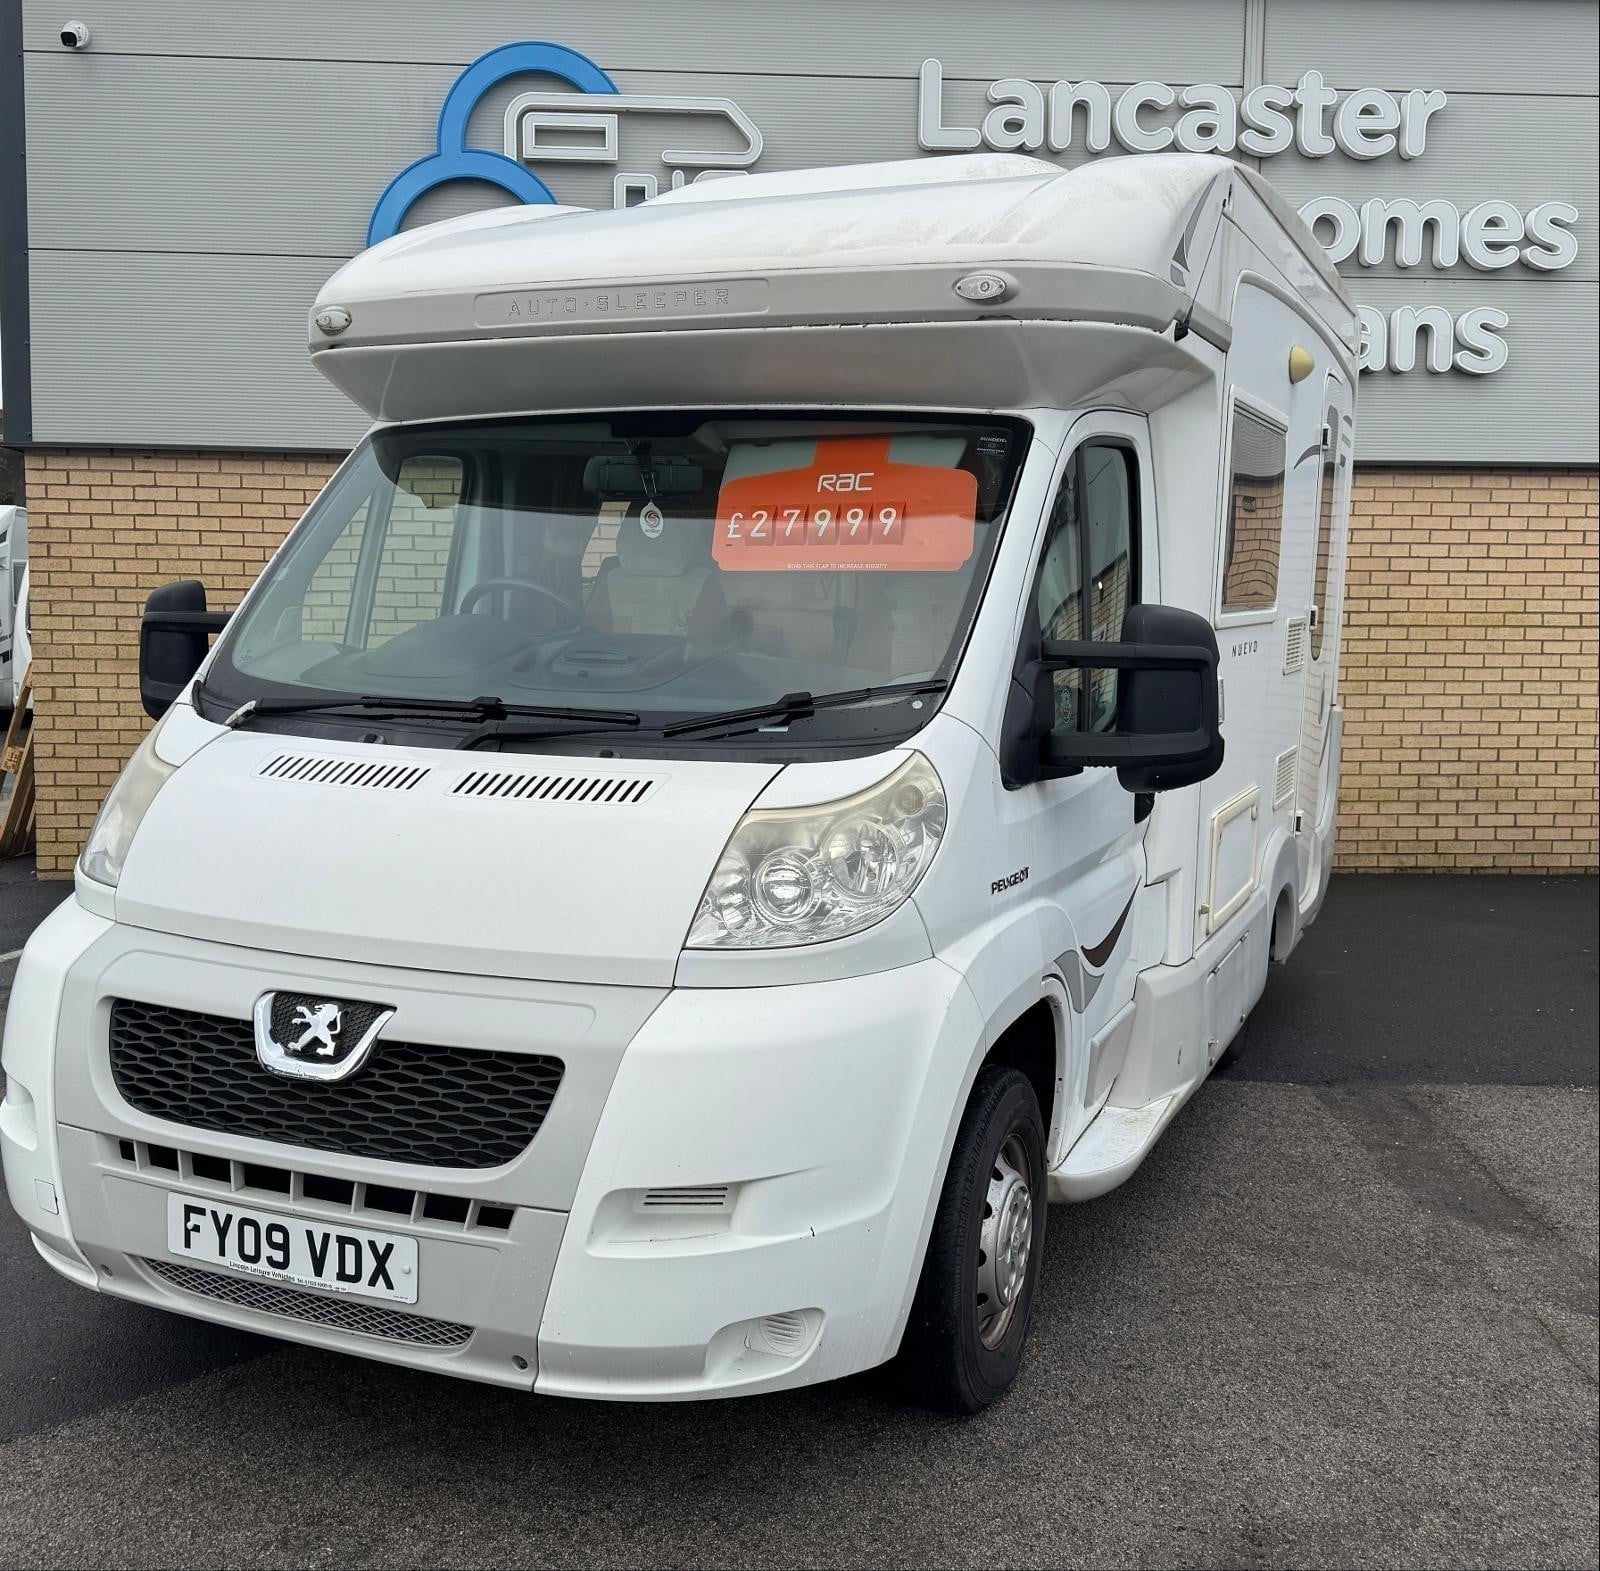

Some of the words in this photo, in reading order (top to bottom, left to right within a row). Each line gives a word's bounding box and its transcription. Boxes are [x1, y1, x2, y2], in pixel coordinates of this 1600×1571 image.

[917, 58, 1447, 161] Lancaster
[1231, 640, 1258, 658] NUEVO
[991, 866, 1030, 895] PEUGEOT
[184, 1204, 290, 1270] FY09
[305, 1229, 395, 1291] VDX
[229, 1261, 249, 1271] Lincoln
[250, 1266, 271, 1277] Leisure
[272, 1271, 295, 1281] Vehicles
